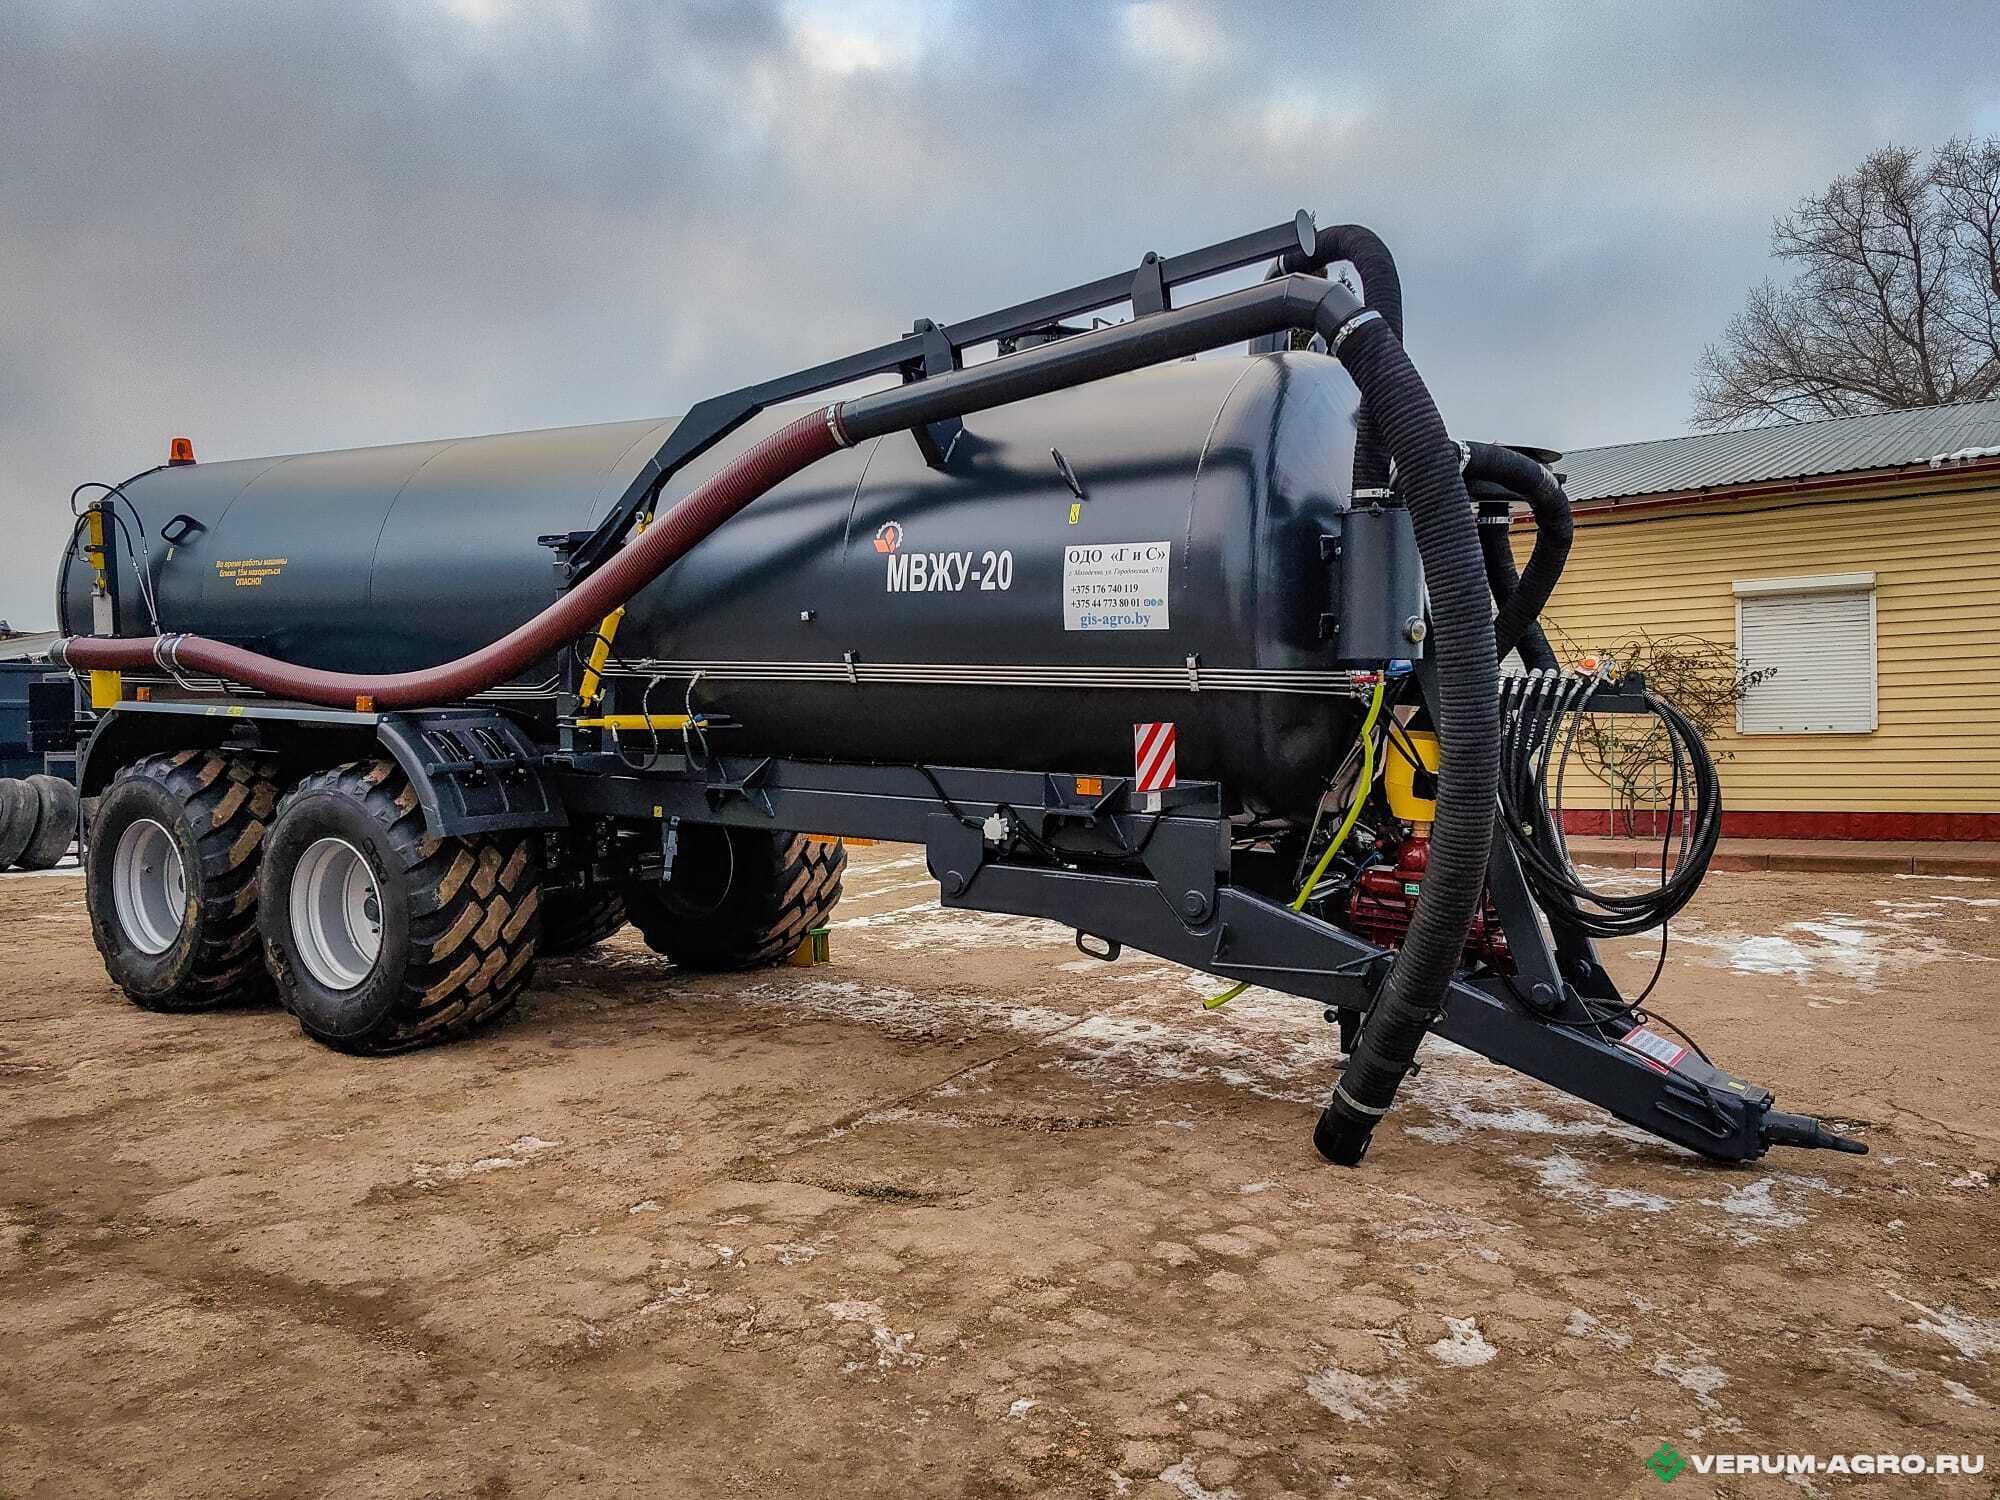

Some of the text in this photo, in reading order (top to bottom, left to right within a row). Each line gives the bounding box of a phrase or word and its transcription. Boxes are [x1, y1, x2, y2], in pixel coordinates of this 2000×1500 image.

[1069, 549, 1103, 566] ОДО
[1133, 551, 1141, 561] и
[886, 550, 1013, 593] МВЖУ-20
[1070, 583, 1139, 594] +375 176 740 119
[1070, 598, 1140, 608] +375 44 773 80 01
[1080, 611, 1151, 629] gis-agro.by
